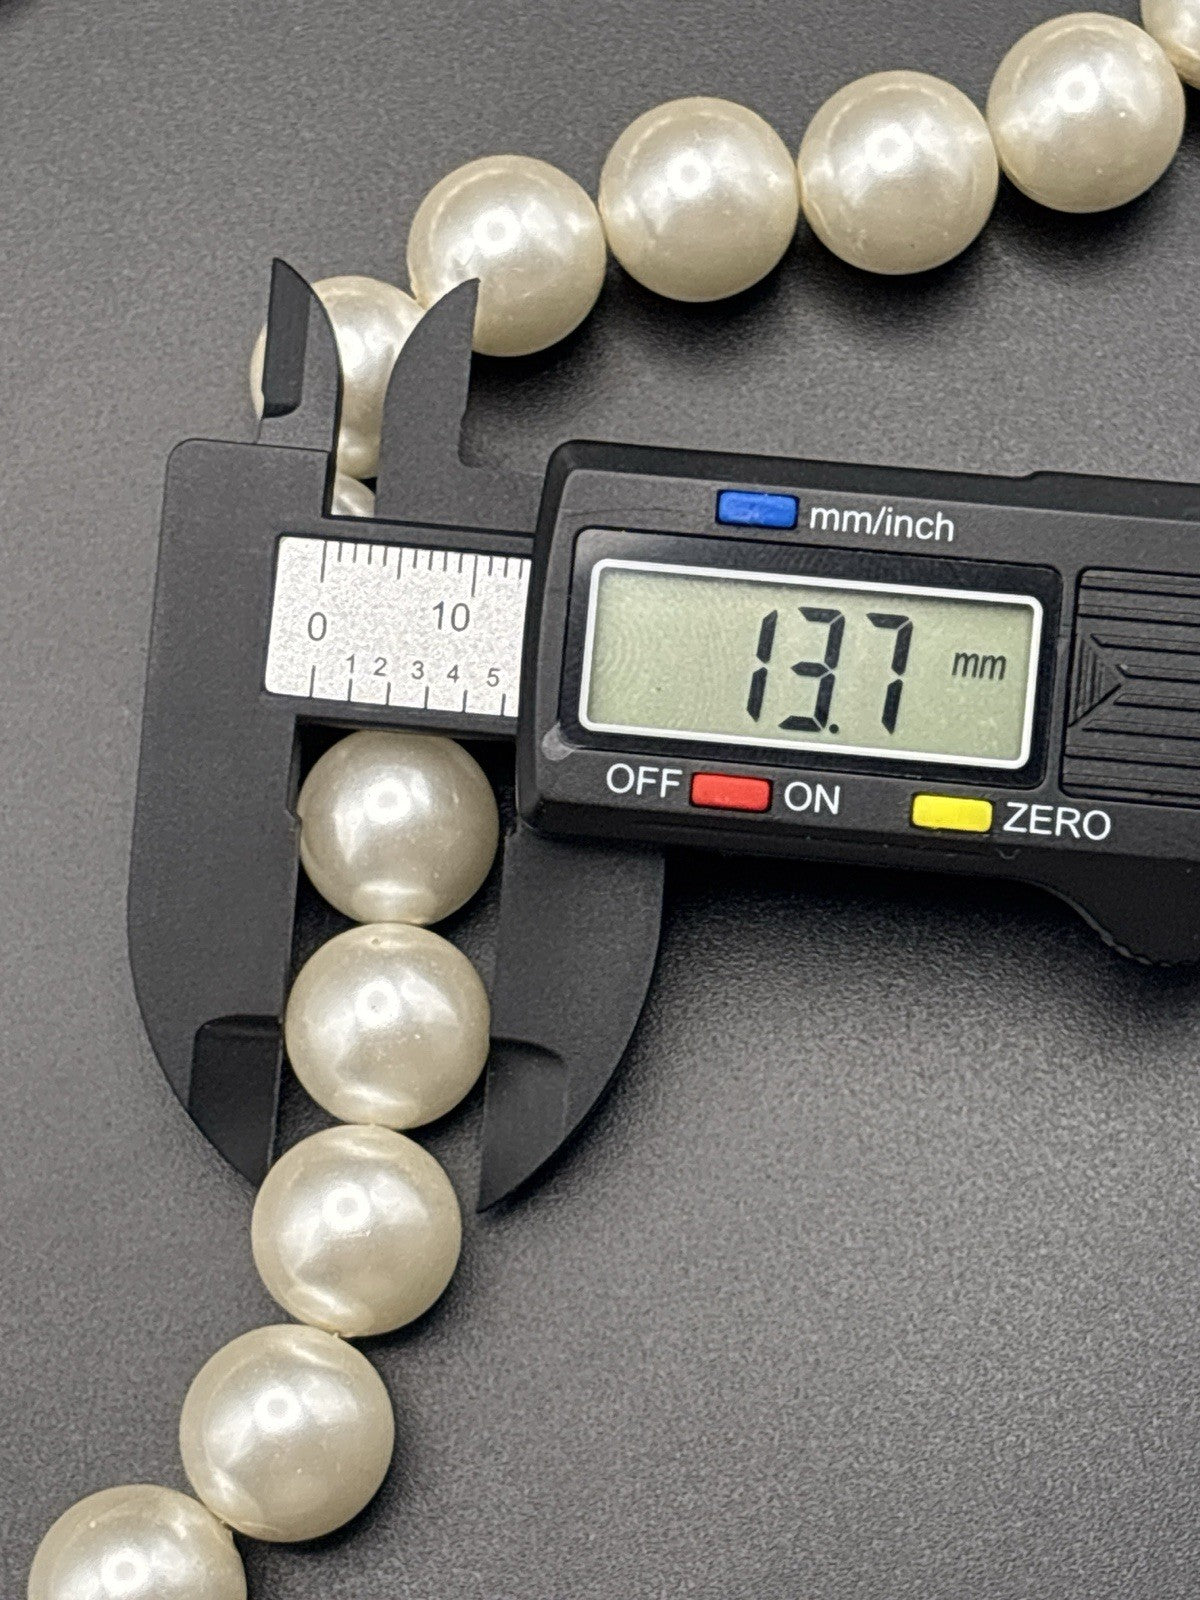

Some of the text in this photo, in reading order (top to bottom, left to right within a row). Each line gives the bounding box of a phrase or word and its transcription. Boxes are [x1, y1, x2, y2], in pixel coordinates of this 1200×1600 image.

[809, 502, 955, 542] mm/inch
[307, 600, 471, 642] 0 10
[346, 654, 501, 687] 1 2 3 4 5
[746, 605, 1008, 736] 13.7 mm
[606, 763, 841, 815] OFF ON
[1003, 801, 1112, 841] ZERO
